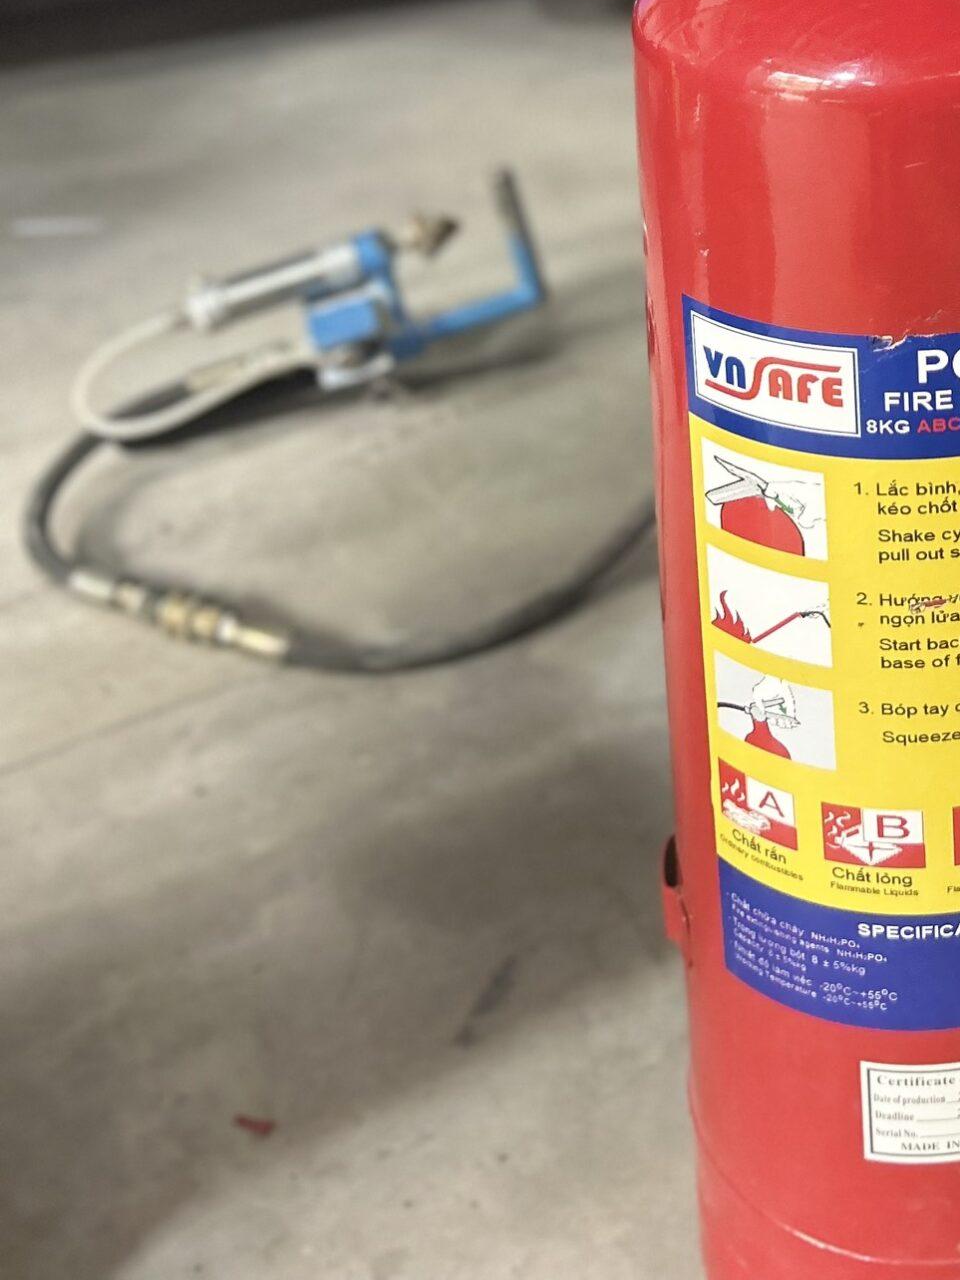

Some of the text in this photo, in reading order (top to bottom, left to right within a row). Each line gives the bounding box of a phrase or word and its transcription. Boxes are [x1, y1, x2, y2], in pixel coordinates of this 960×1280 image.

[884, 389, 953, 412] FIRE
[866, 419, 910, 434] 8KG
[917, 417, 960, 433] ABC
[854, 482, 869, 496] 1.
[878, 500, 911, 515] kéo
[918, 496, 957, 513] chốt
[878, 529, 935, 543] Shake
[878, 549, 910, 564] pull
[916, 547, 944, 561] out
[856, 593, 873, 606] 2.
[879, 638, 921, 652] Start
[880, 656, 925, 669] base
[931, 655, 950, 669] of
[858, 701, 874, 715] 3.
[881, 700, 917, 719] Bóp
[923, 703, 949, 717] tay
[759, 791, 785, 818] A
[877, 815, 910, 839] B
[832, 866, 871, 883] Chất
[830, 881, 880, 895] Flammable
[877, 1074, 955, 1087] Certificate
[873, 1093, 891, 1104] Date
[893, 1095, 901, 1103] of
[902, 1094, 946, 1106] production
[875, 1110, 915, 1121] Deadline
[875, 1128, 902, 1138] Serial
[904, 1129, 919, 1138] No.
[901, 1142, 940, 1151] MADE
[947, 1140, 960, 1149] IN
